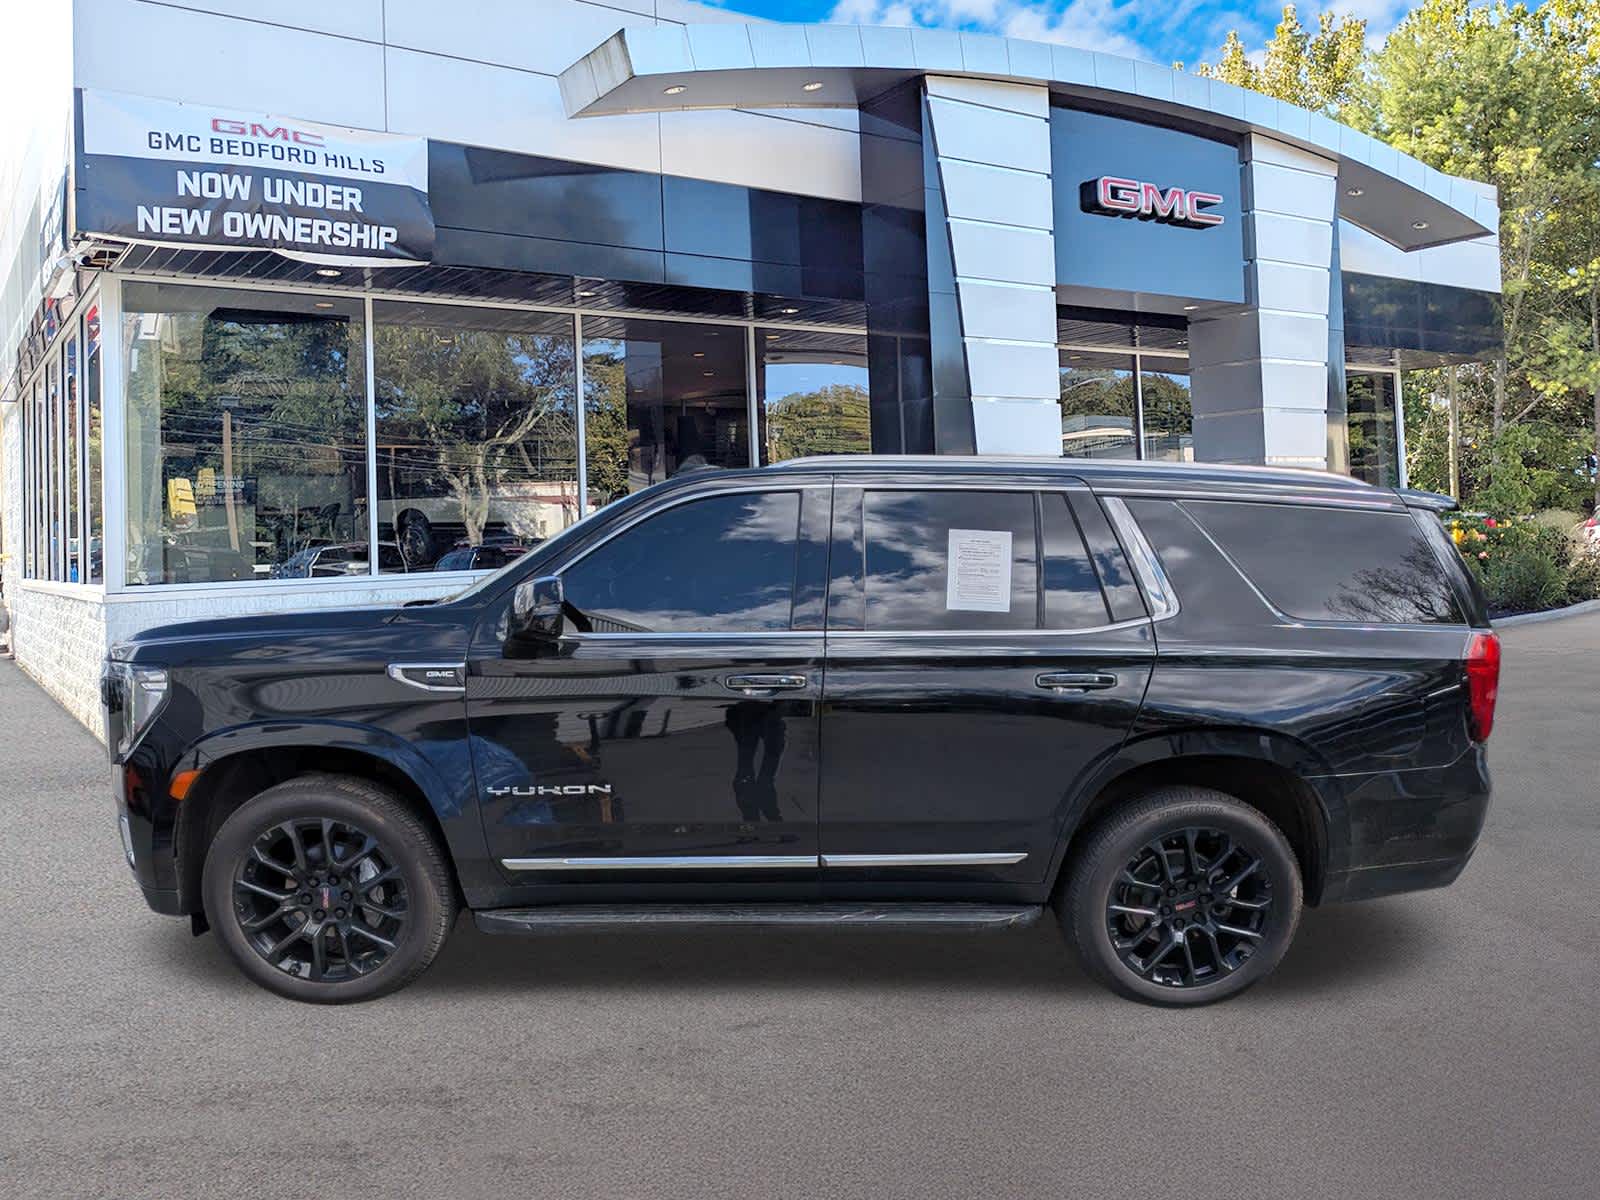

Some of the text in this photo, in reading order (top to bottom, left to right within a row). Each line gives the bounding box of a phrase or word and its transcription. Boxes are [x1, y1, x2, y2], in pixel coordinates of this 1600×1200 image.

[148, 131, 385, 174] GMC BEDFORD HILLS
[211, 118, 326, 148] GMC
[176, 170, 364, 213] NOW UNDER
[1098, 175, 1225, 224] GMC
[136, 205, 398, 250] NEW OWNERSHIP
[487, 784, 612, 796] YUKON
